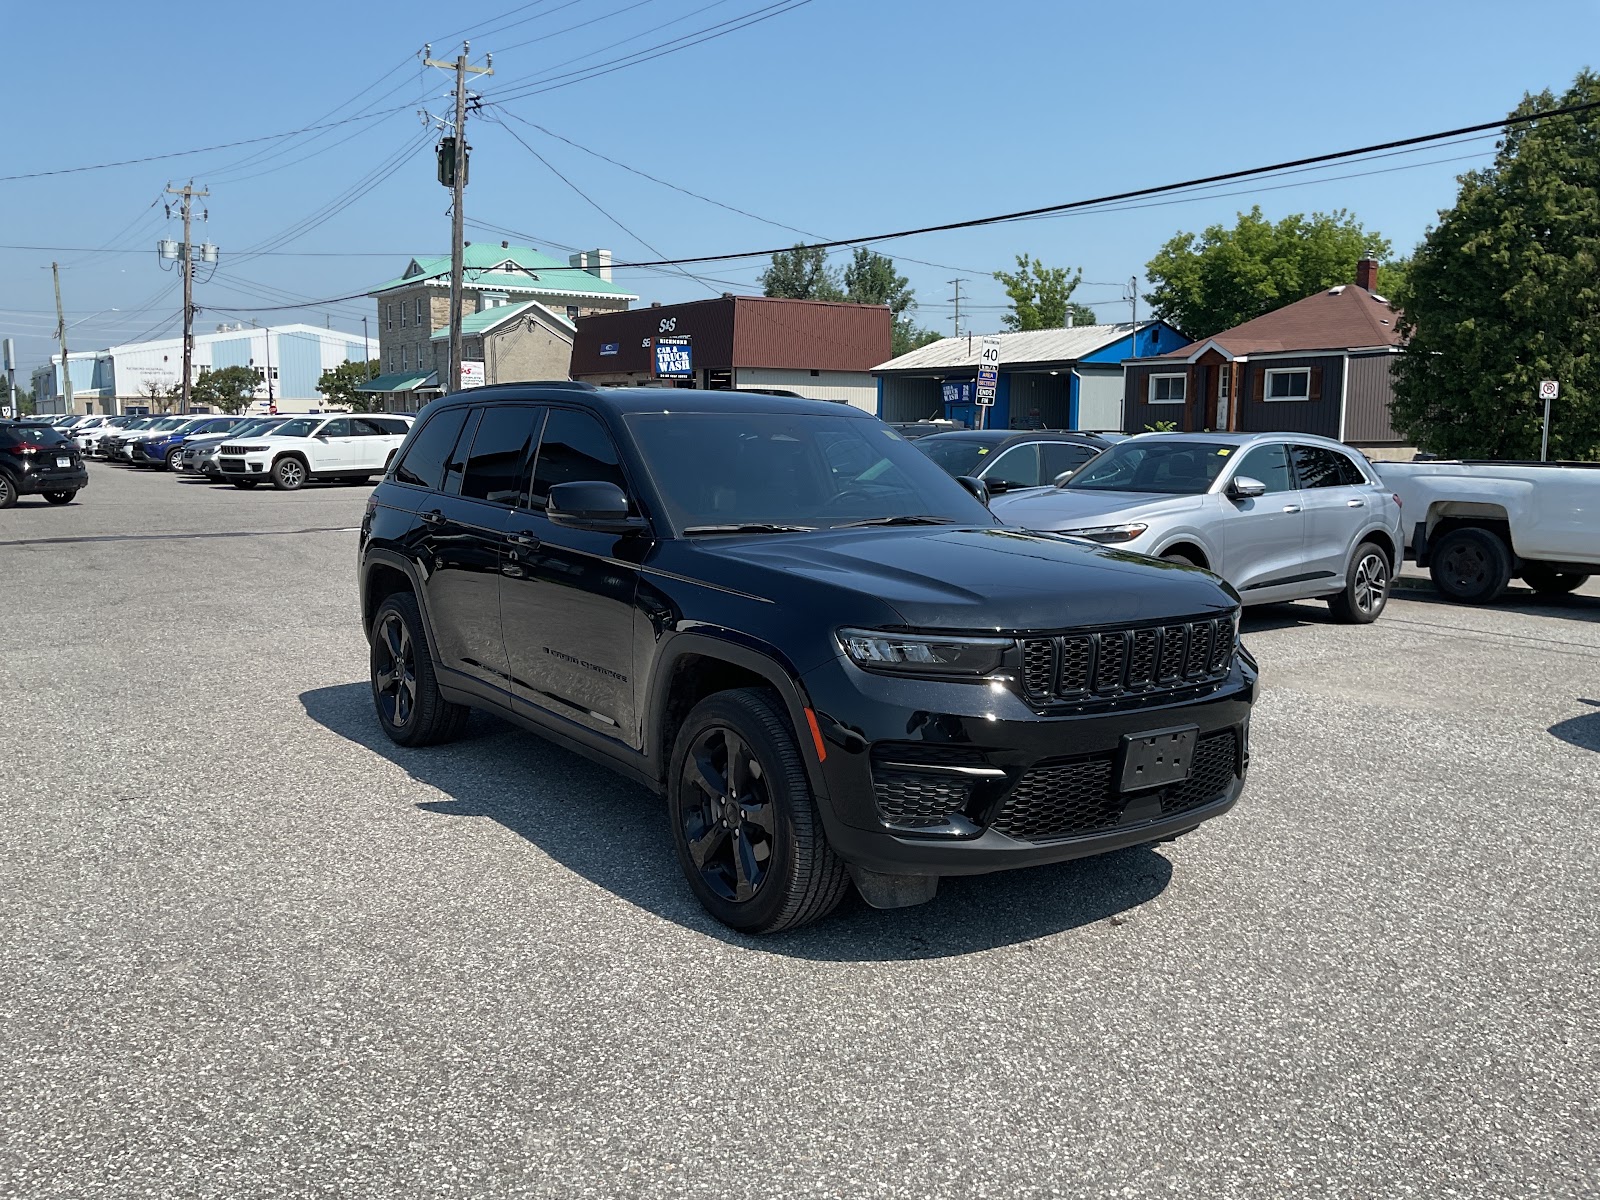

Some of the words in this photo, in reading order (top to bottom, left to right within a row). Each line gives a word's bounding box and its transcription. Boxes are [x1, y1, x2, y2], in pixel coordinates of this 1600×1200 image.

[659, 317, 676, 333] S&S
[658, 352, 689, 362] TRUCK
[983, 348, 998, 361] 40
[659, 360, 690, 372] WASH
